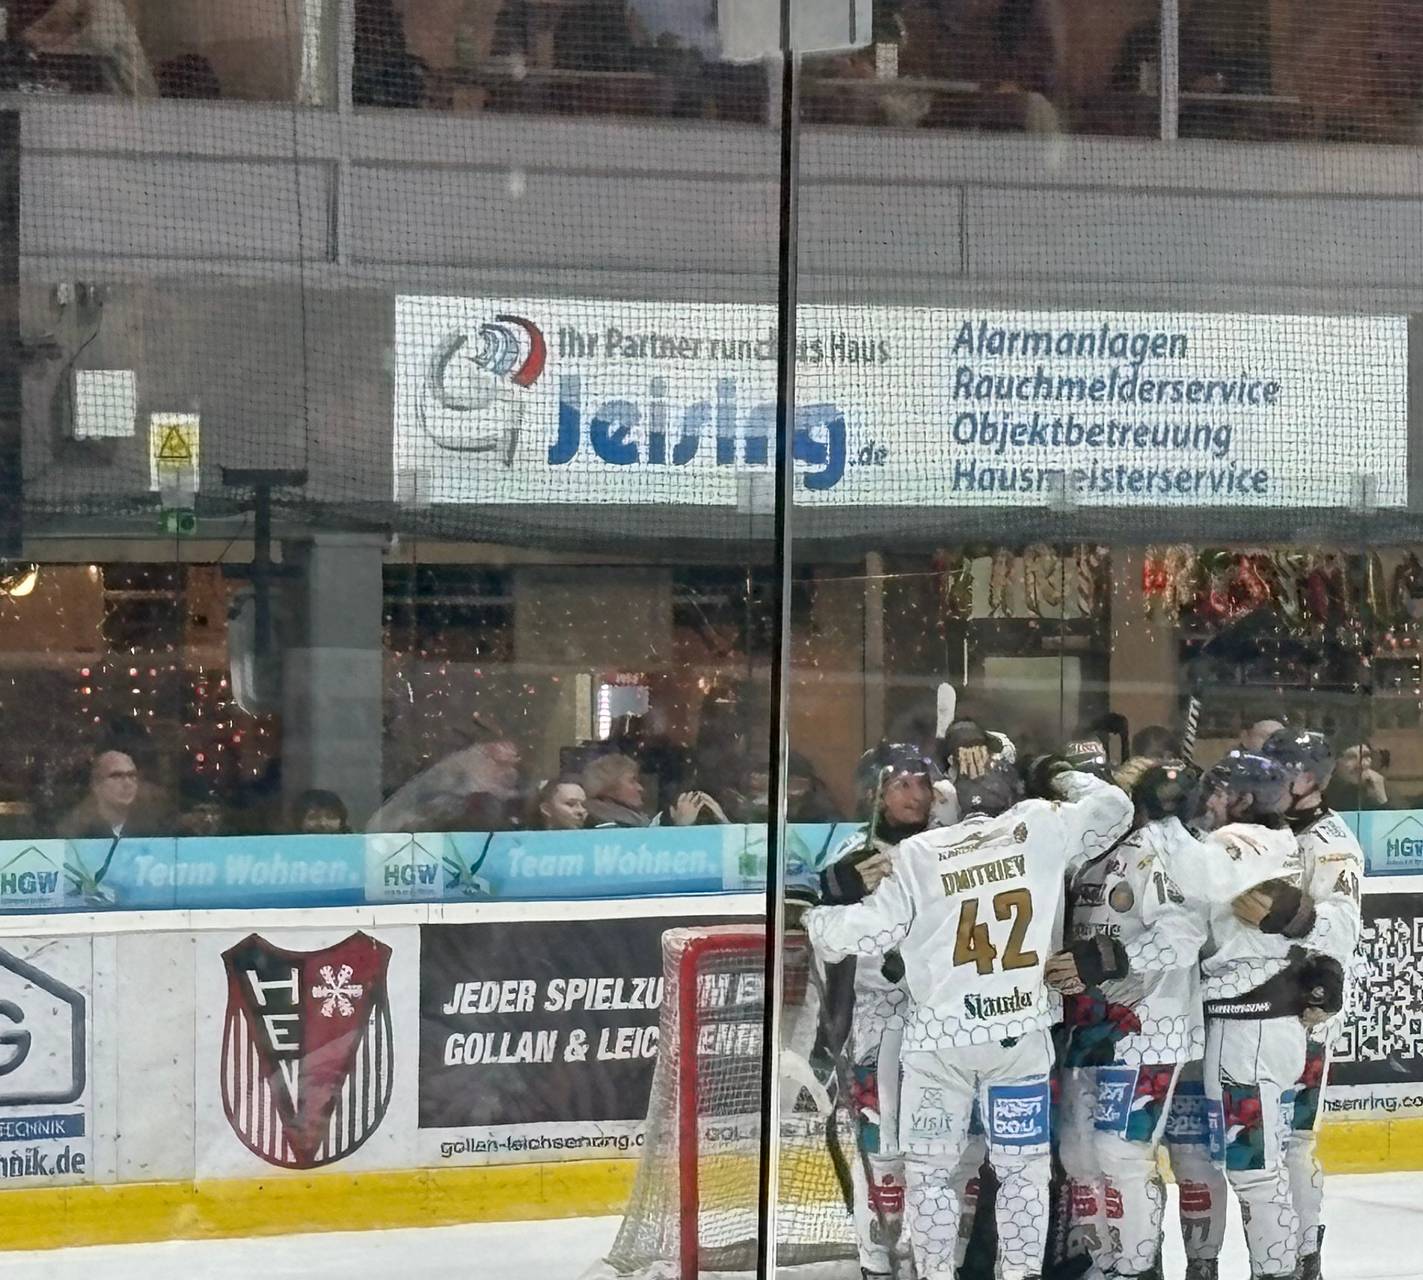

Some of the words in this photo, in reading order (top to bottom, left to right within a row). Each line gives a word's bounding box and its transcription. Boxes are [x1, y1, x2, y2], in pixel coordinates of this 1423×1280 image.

[557, 326, 594, 357] Ihr
[605, 328, 700, 361] Partner
[830, 330, 893, 364] Haus
[953, 319, 1188, 363] Alarmanlagen
[953, 365, 1282, 404] Rauchmelderservice
[953, 410, 1233, 457] Objektbetreuung
[134, 852, 217, 887] Team
[384, 862, 438, 886] HGW
[507, 846, 584, 877] Team
[594, 841, 720, 875] Wohnen.
[941, 854, 1027, 897] DMITRIEV
[1, 871, 58, 895] HGW
[953, 887, 1040, 976] 42
[443, 979, 537, 1014] JEDER
[544, 976, 667, 1010] SPIELZU
[443, 1028, 558, 1065] GOLLAN
[563, 1027, 589, 1062] &
